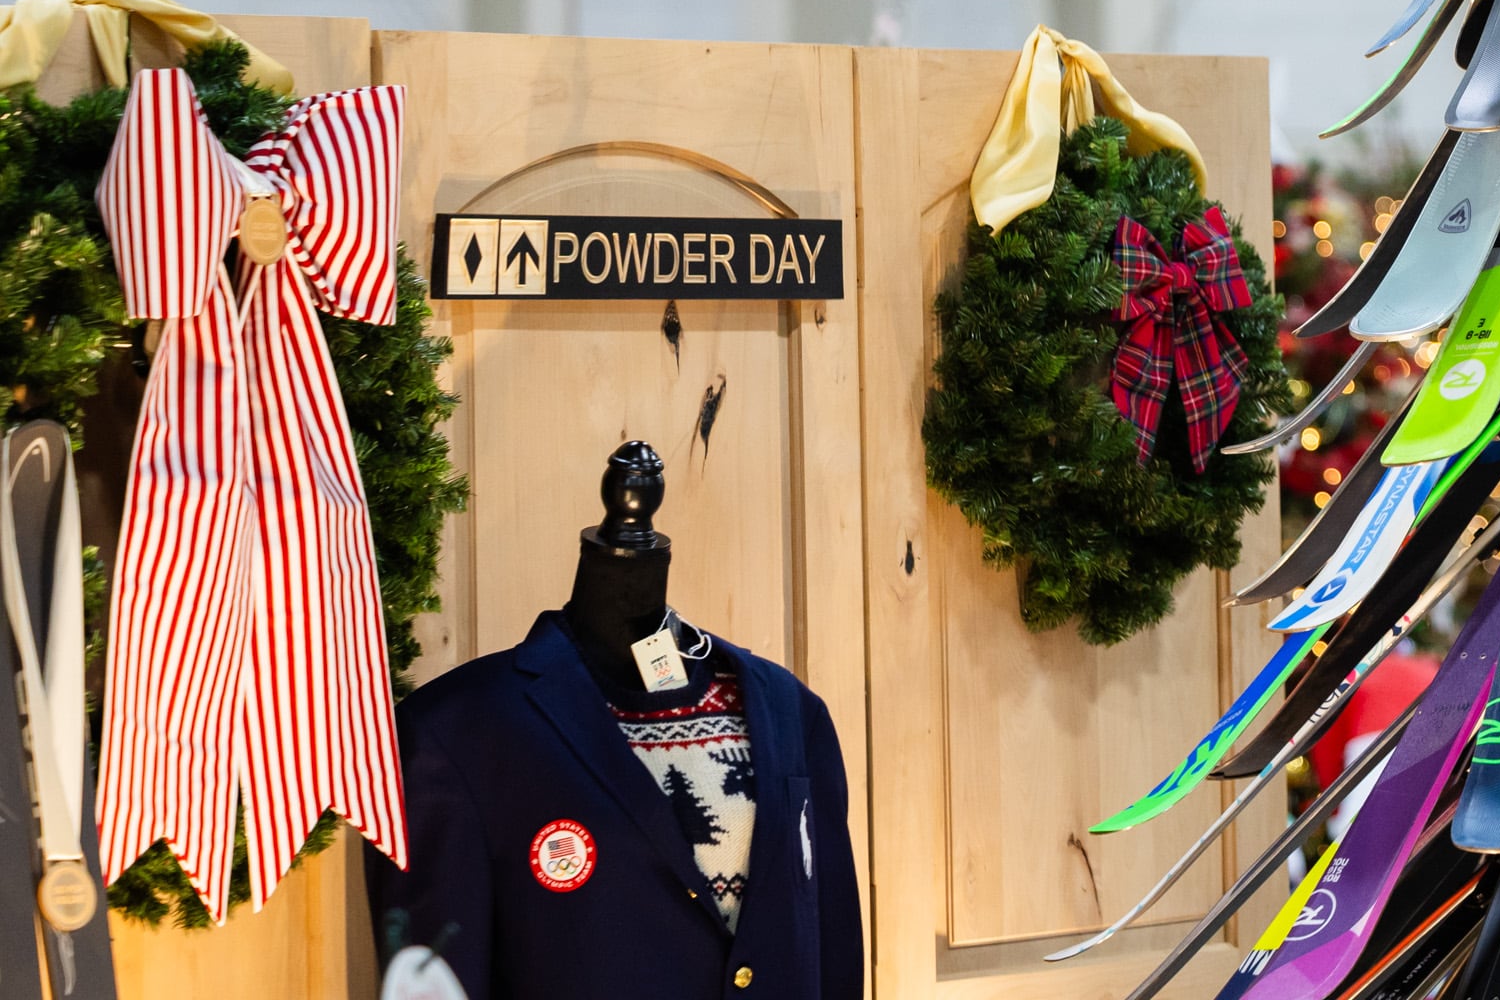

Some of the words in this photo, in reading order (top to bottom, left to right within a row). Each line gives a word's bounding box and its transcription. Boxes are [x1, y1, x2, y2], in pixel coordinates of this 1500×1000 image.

[553, 231, 738, 285] POWDER
[749, 233, 826, 285] DAY
[1350, 466, 1417, 564] DYNASTAR
